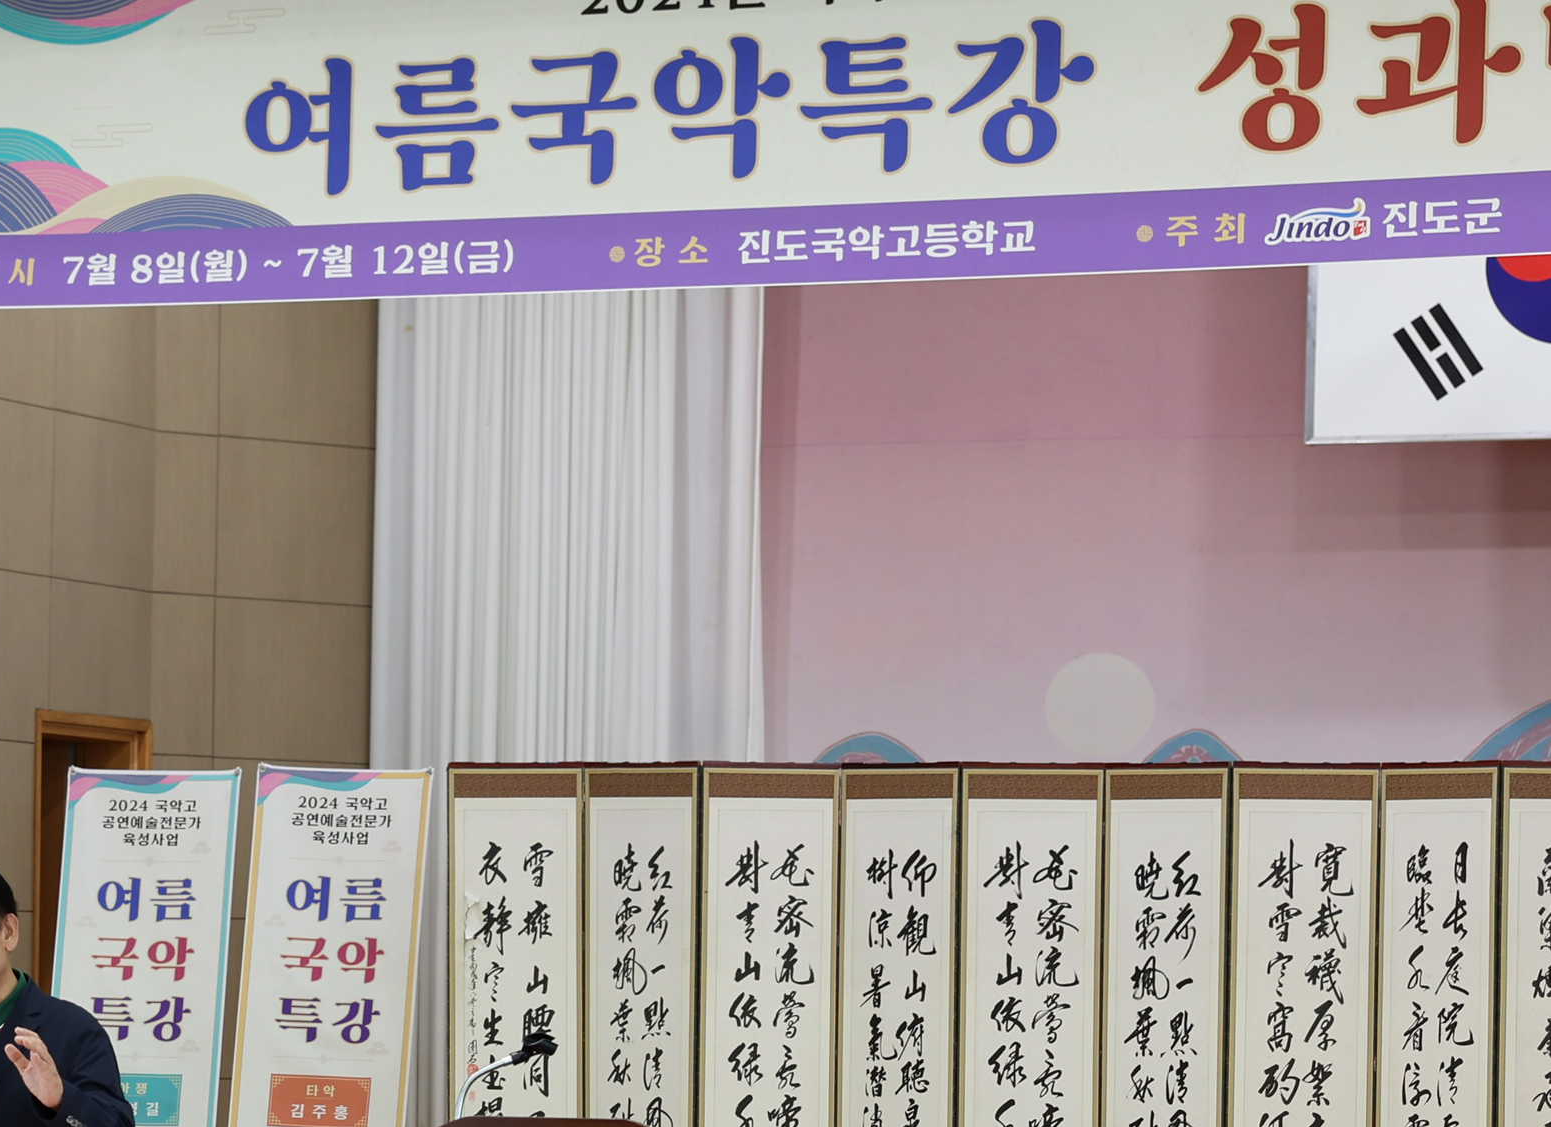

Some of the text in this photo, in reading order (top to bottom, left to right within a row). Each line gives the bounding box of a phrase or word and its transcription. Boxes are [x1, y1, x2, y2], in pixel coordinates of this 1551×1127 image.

[243, 0, 1551, 197] 여름국악특강 성과
[1265, 214, 1352, 244] Jindo
[1381, 198, 1503, 239] 진도군
[737, 220, 1037, 266] 진도국악고등학교
[62, 252, 117, 287] 7월
[130, 248, 248, 285] 8일(월)
[296, 243, 354, 279] 7월
[372, 238, 515, 276] 12일(금)
[108, 799, 197, 813] 2024 국악고
[298, 796, 388, 812] 2024 국악고
[102, 815, 202, 831] 공연예술전문가
[291, 812, 393, 829] 공연예술전문가
[122, 832, 180, 847] 육성사업
[312, 829, 370, 846] 육성사업
